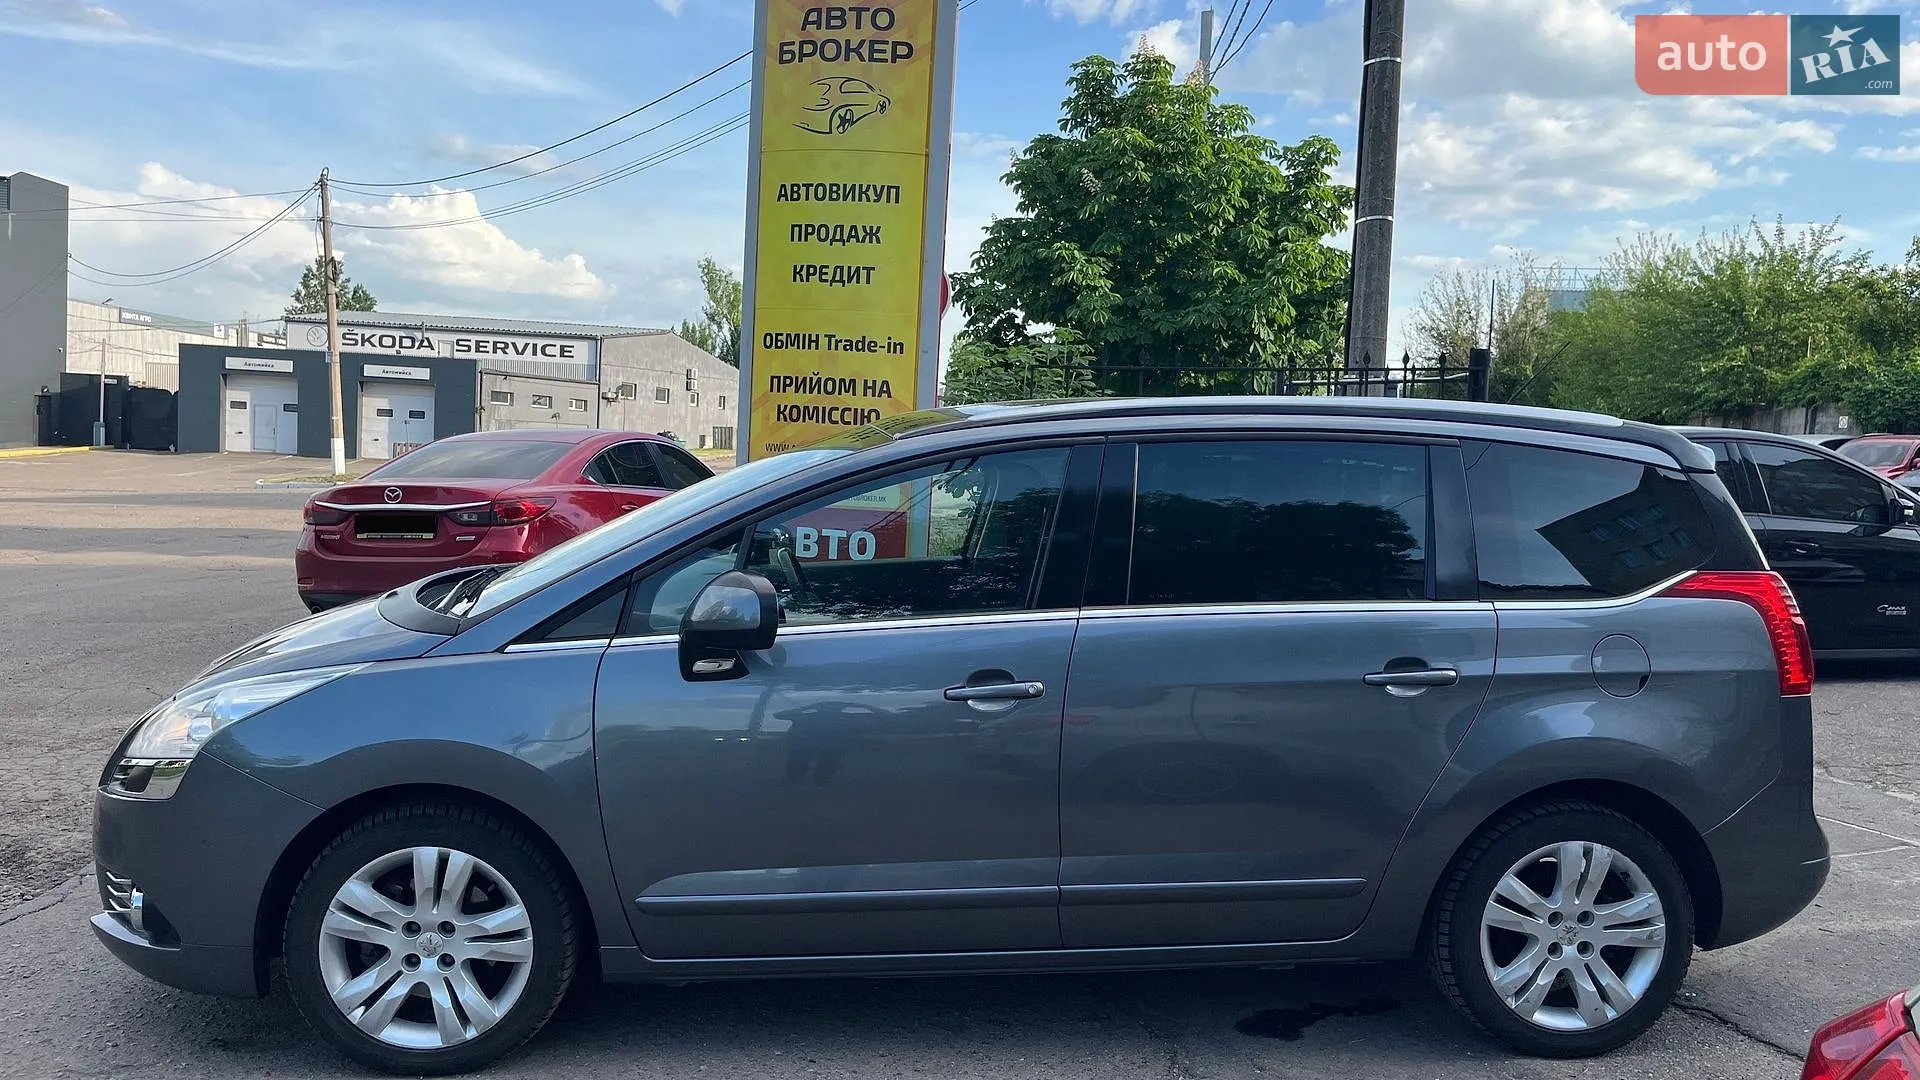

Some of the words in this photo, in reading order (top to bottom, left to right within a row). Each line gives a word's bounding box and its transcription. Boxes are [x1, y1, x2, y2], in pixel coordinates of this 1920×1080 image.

[801, 7, 895, 30] АВТО
[778, 39, 914, 64] БРОКЕР
[776, 183, 900, 204] АВТОВИКУП
[790, 223, 881, 245] ПРОДАЖ
[792, 264, 876, 287] КРЕДИТ
[342, 328, 436, 351] ŠKODA
[455, 339, 575, 359] SERVICE
[763, 332, 820, 350] ОБМІН
[824, 334, 905, 355] Trade-in
[769, 372, 857, 397] ПРИЙОМ
[862, 379, 892, 398] НА
[776, 404, 881, 426] КОМІССІЮ
[795, 526, 877, 561] ВТО
